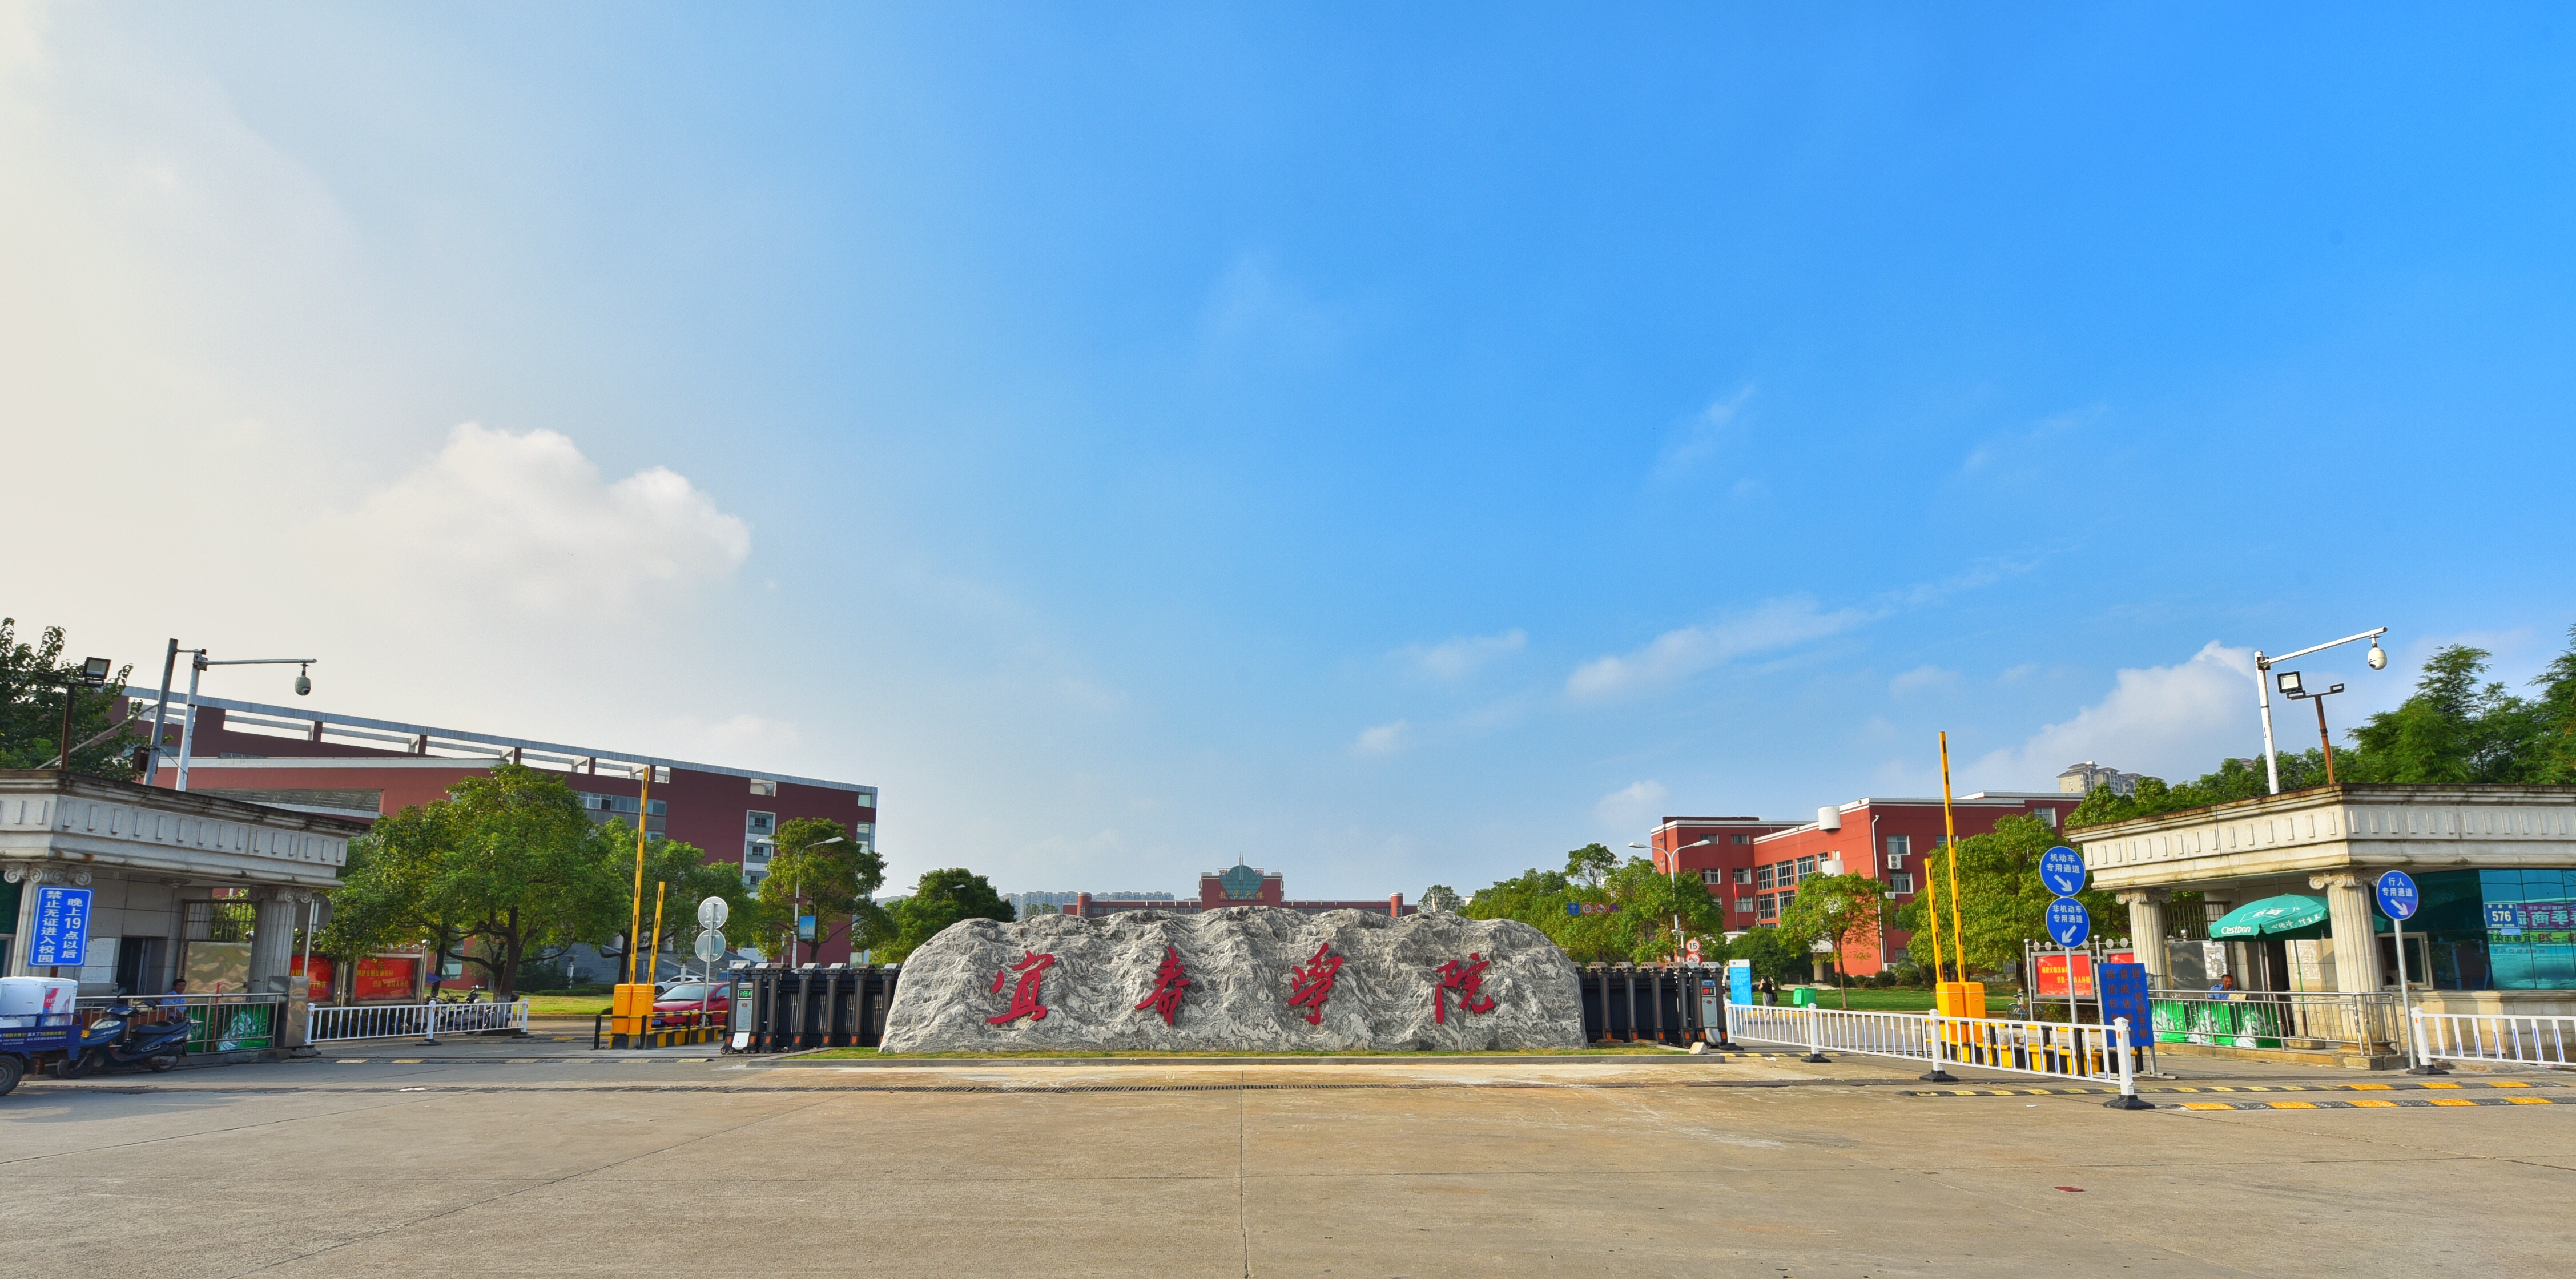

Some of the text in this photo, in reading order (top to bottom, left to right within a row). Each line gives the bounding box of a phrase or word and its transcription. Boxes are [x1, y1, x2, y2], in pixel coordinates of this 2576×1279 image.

[2050, 853, 2075, 863] 机动车
[2046, 863, 2080, 874] 专用通道
[2388, 877, 2405, 886] 行人
[1219, 890, 1265, 899] 教学大楼
[2382, 887, 2413, 897] 专用通道
[2052, 904, 2082, 914] 非机动车
[2053, 914, 2083, 923] 专用通道
[2492, 911, 2511, 922] 576
[38, 891, 62, 963] 禁止无证进入校园
